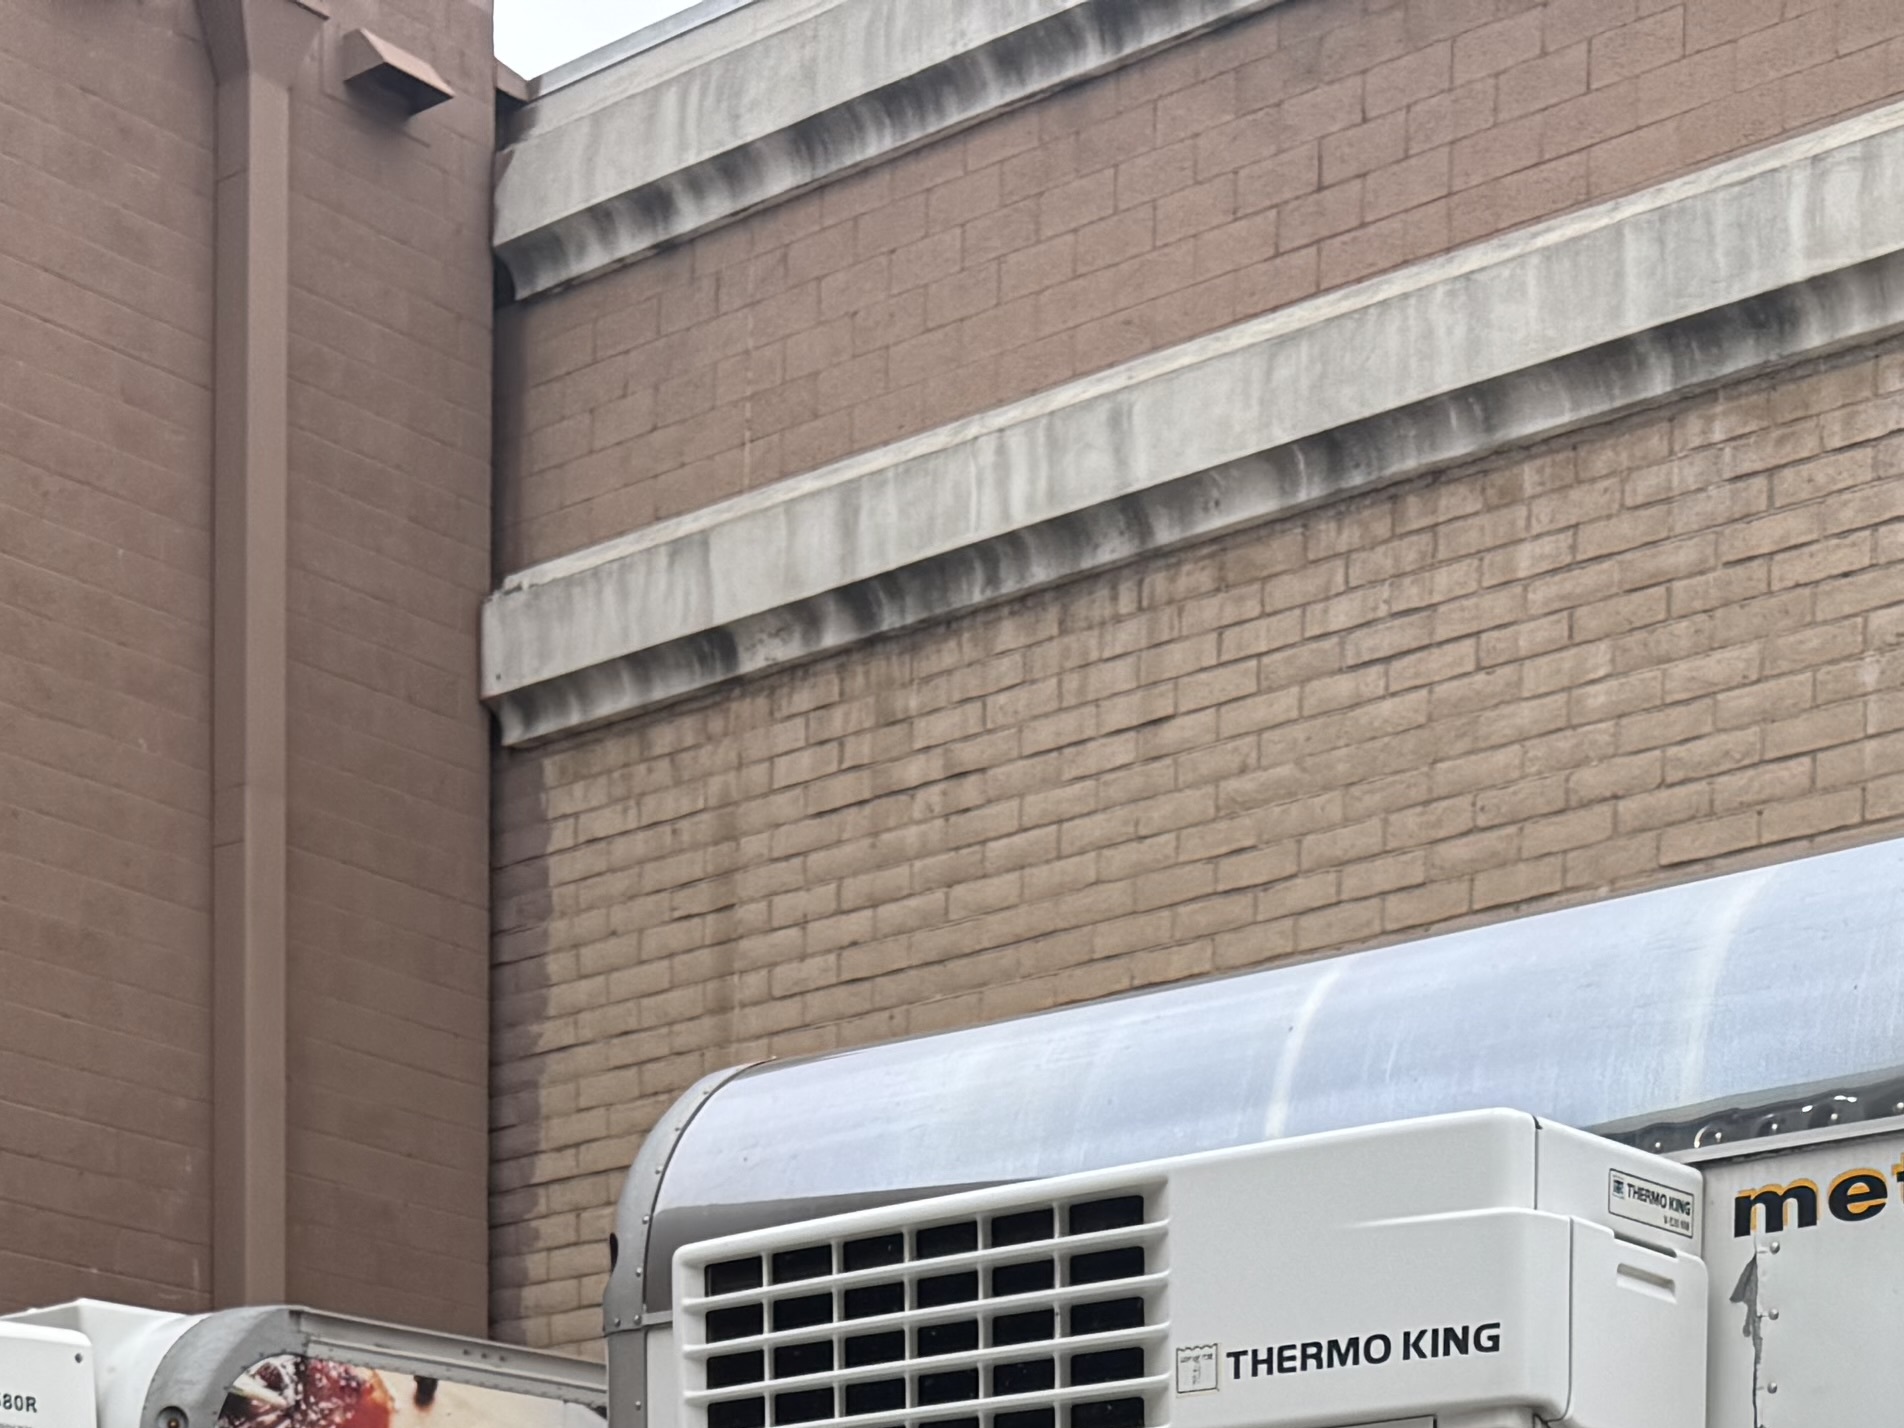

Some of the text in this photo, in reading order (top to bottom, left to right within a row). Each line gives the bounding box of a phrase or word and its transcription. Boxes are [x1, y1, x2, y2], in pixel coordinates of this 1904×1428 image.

[1627, 1182, 1667, 1209] THERMO
[1669, 1196, 1691, 1216] KING
[1226, 1333, 1392, 1380] THERMO
[1402, 1322, 1501, 1361] KING
